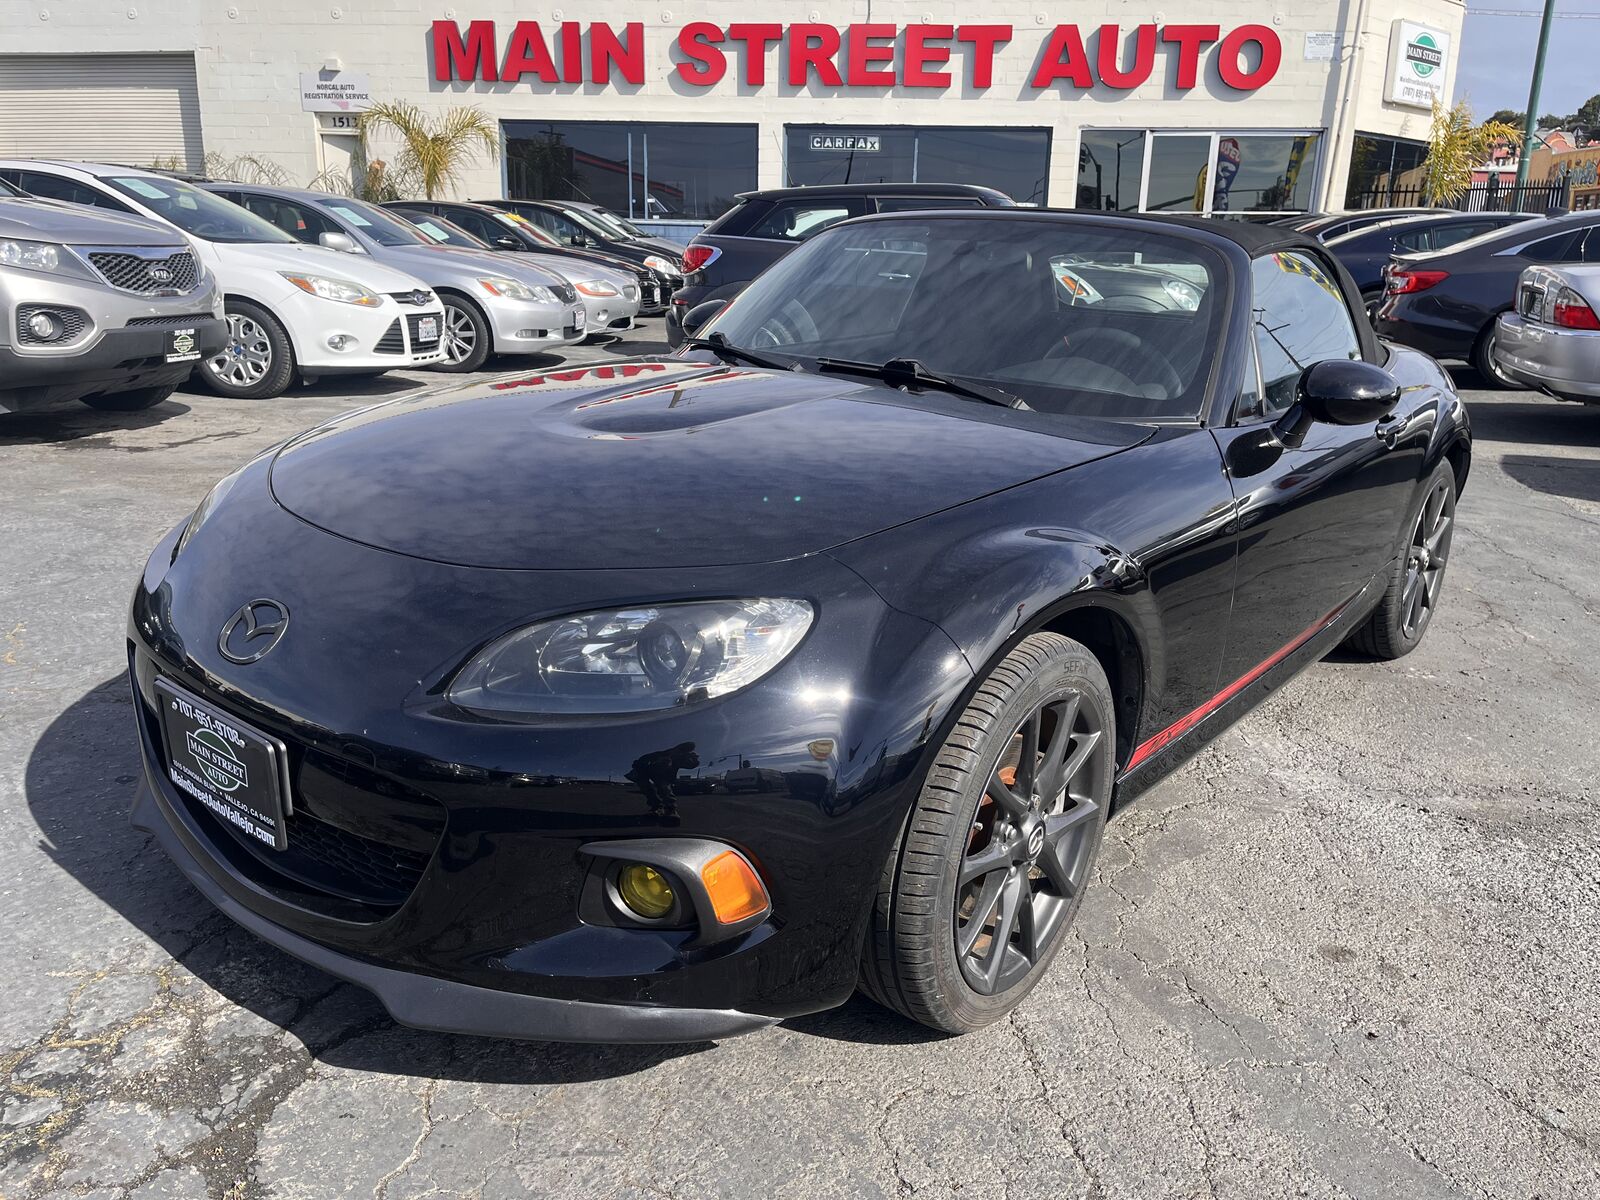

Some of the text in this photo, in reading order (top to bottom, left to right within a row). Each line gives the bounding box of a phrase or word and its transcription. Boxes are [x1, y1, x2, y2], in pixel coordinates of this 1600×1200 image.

[432, 20, 1283, 91] MAIN STREET AUTO
[1407, 46, 1442, 63] MAIN STREET
[304, 92, 344, 100] REGISTRATION
[316, 83, 339, 91] NORCAL
[813, 137, 877, 150] CARFAX
[175, 697, 240, 743] 707-651-9708
[189, 738, 244, 779] MAIN STREET
[207, 765, 229, 785] AUTO
[170, 767, 276, 847] MainStreetAutoVallejo.com
[250, 808, 260, 818] CA
